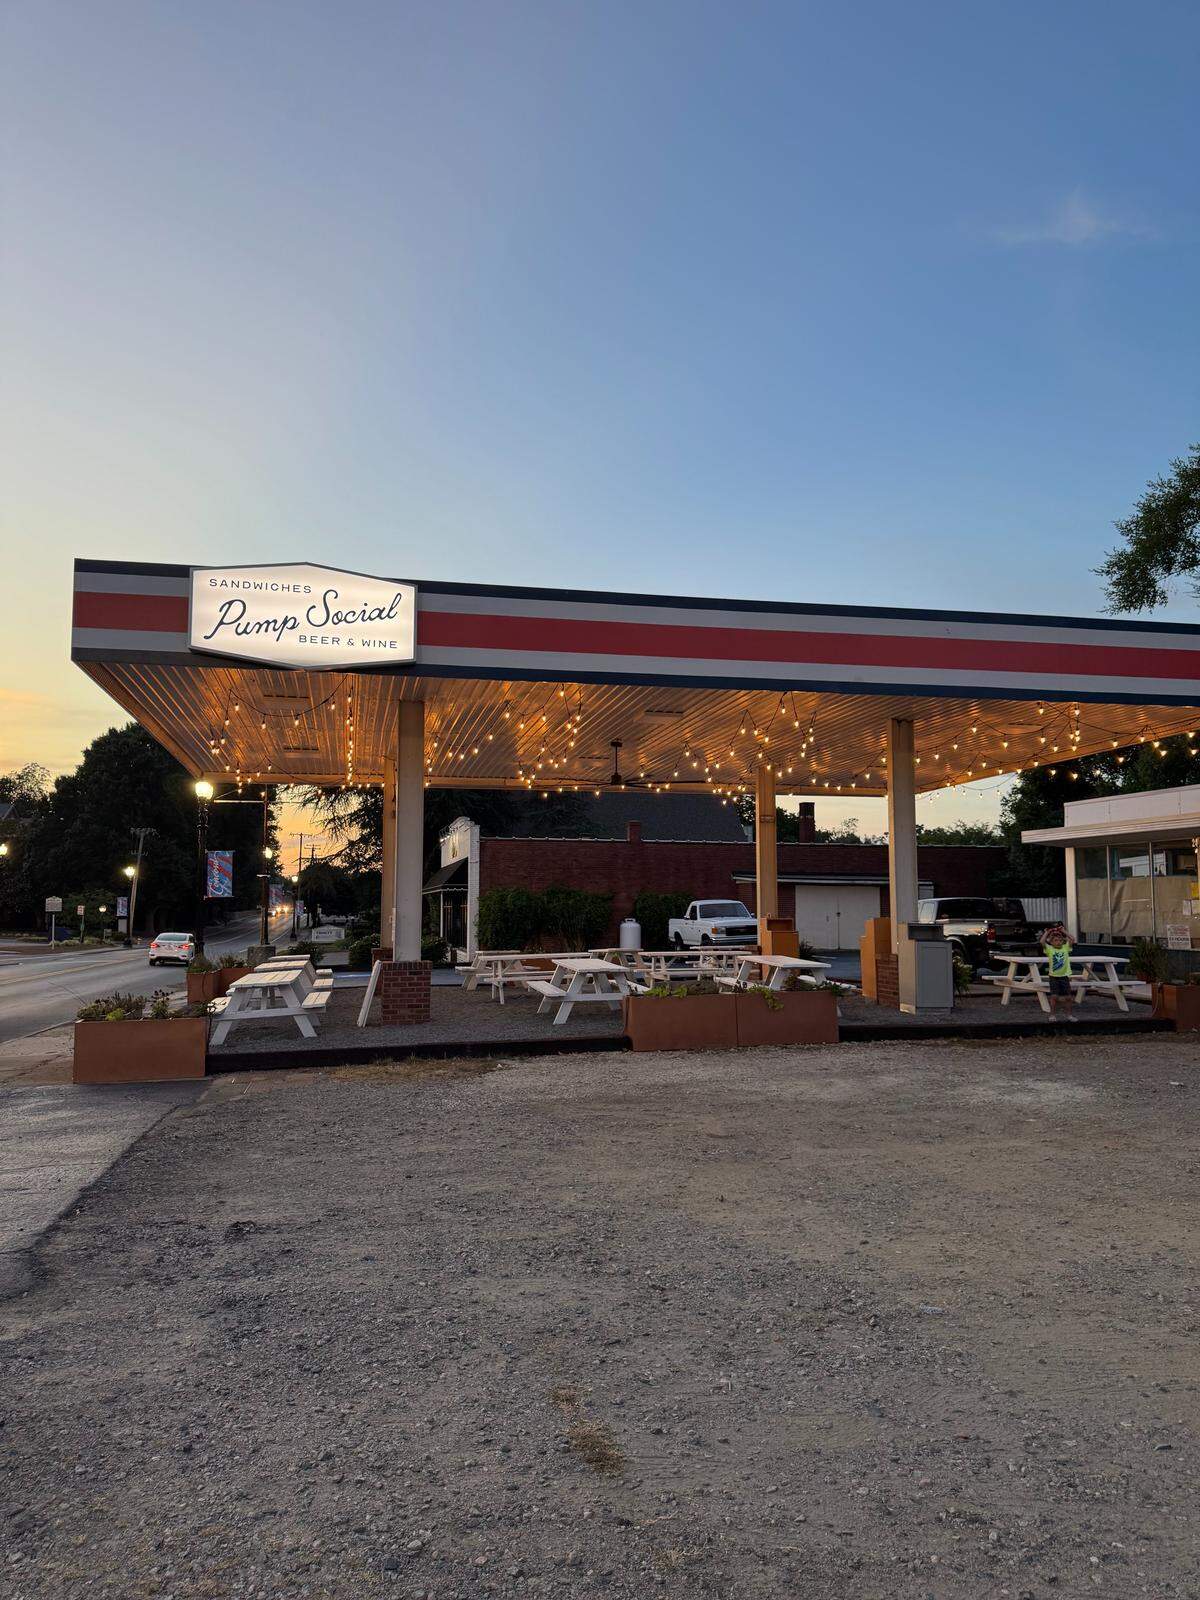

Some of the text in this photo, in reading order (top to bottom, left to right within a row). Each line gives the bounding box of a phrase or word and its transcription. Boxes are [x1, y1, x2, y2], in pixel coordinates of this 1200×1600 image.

[209, 578, 312, 593] SANDWICHES
[203, 589, 402, 642] Pump Social
[298, 634, 398, 649] BEER & WINE
